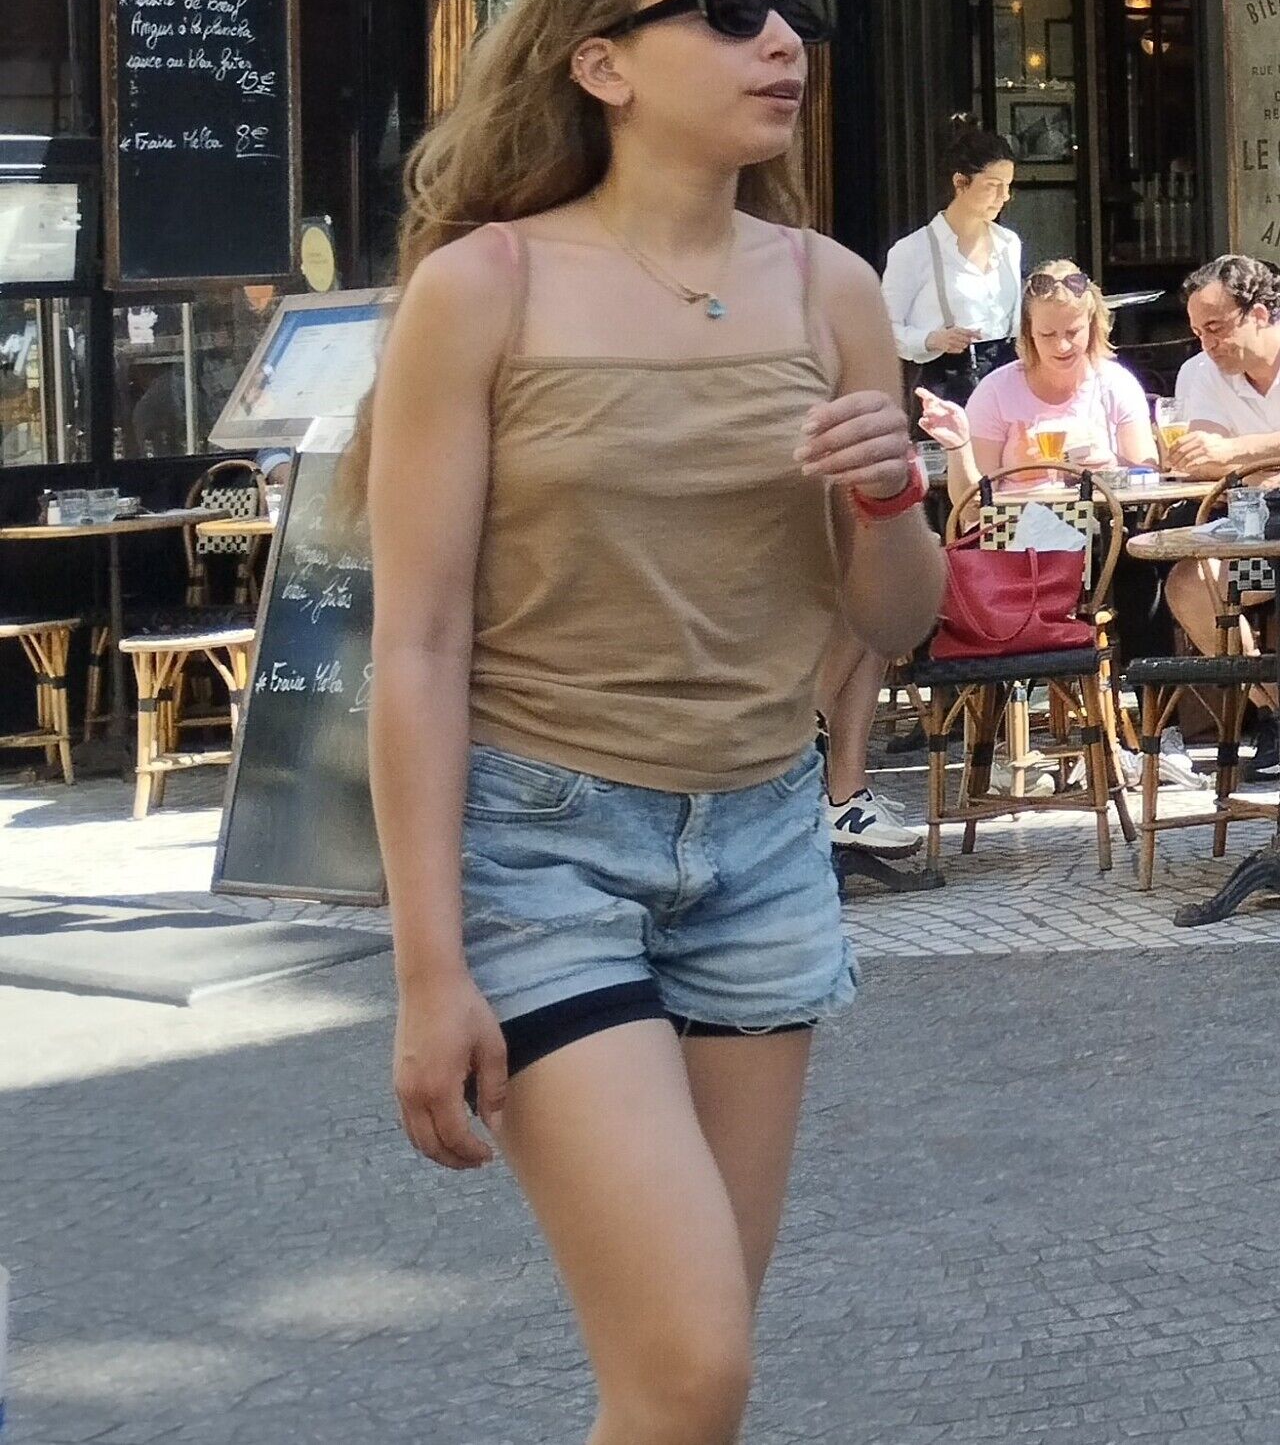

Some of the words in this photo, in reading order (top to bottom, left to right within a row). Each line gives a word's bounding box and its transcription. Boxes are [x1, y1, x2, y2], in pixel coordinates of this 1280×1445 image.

[130, 10, 174, 50] Angus
[1251, 65, 1274, 76] RUE
[1242, 138, 1269, 171] LE
